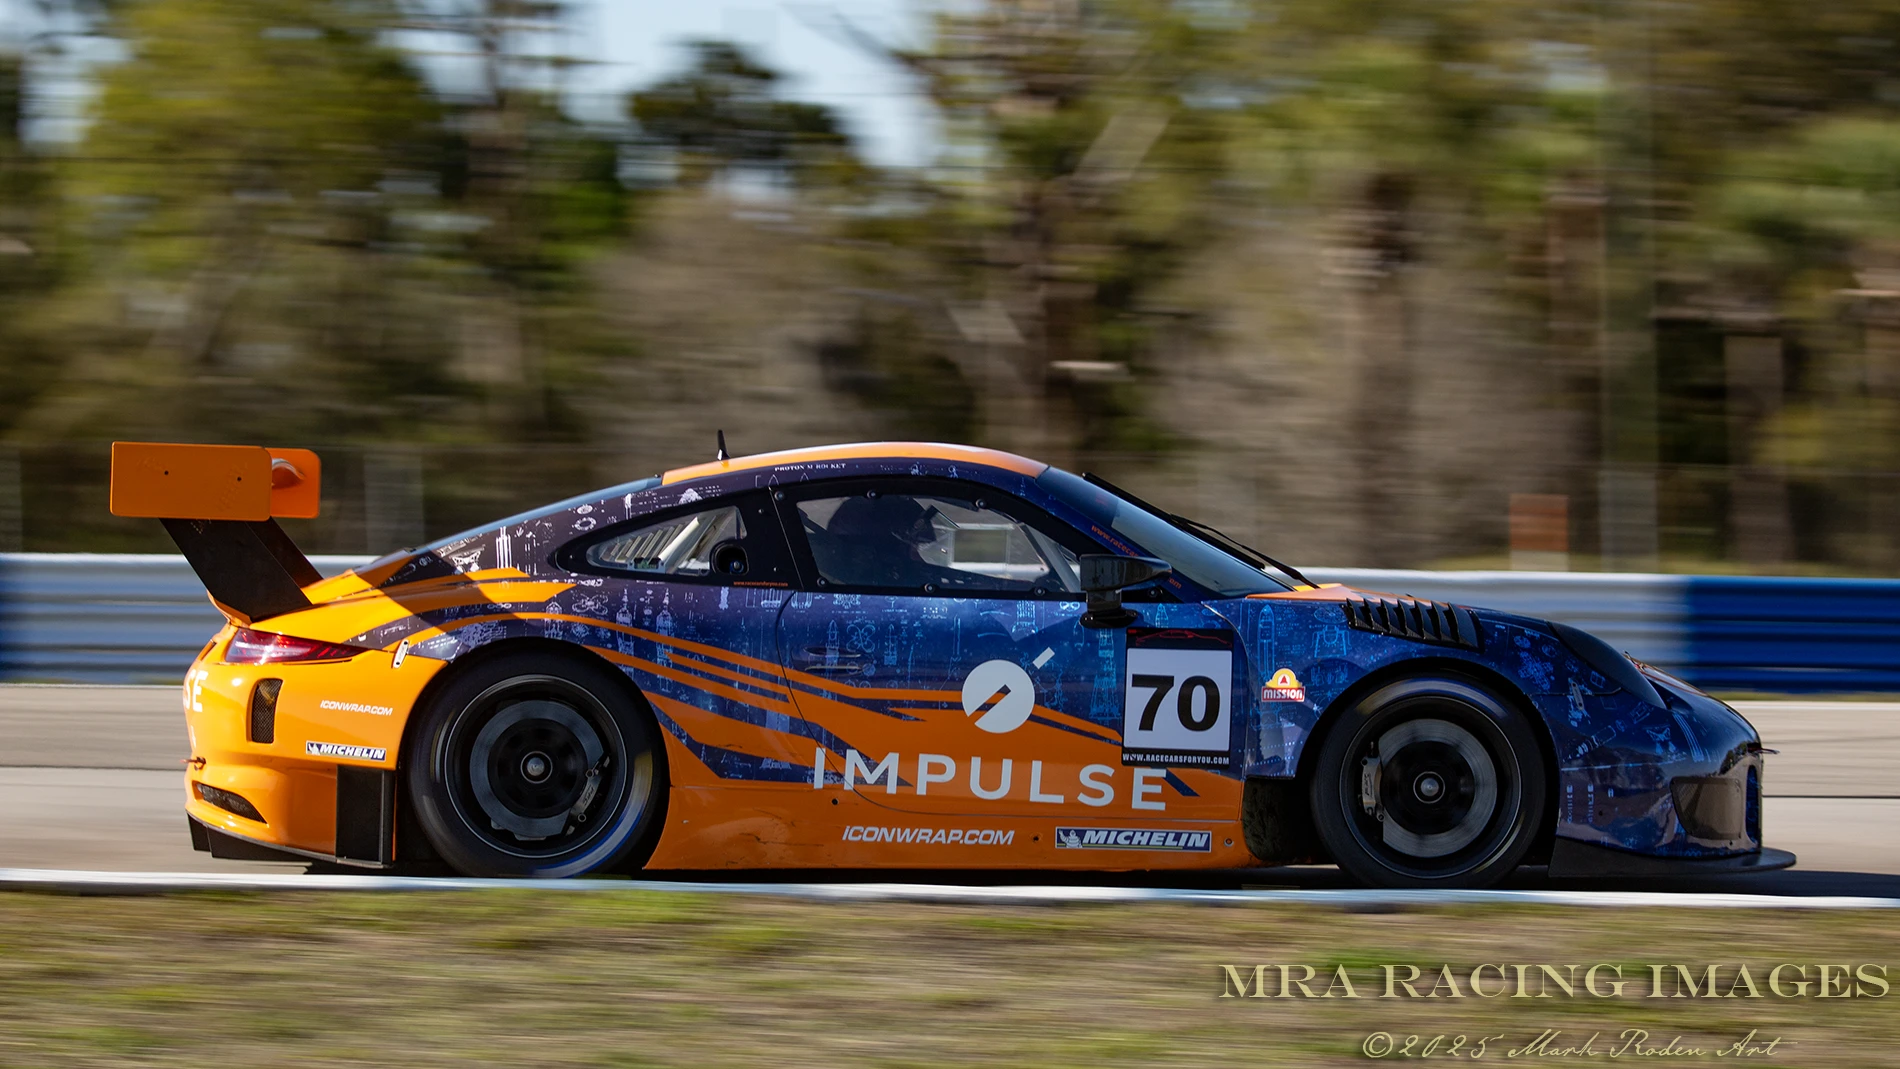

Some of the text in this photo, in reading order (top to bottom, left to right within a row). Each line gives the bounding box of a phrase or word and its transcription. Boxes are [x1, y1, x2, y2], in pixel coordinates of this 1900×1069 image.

[1131, 673, 1221, 732] 70
[320, 744, 385, 759] MICHELIN
[1122, 753, 1230, 765] WWW.RACECARSFORYOU.COM
[813, 747, 1167, 811] IMPULSE
[1083, 830, 1208, 847] MICHELIN
